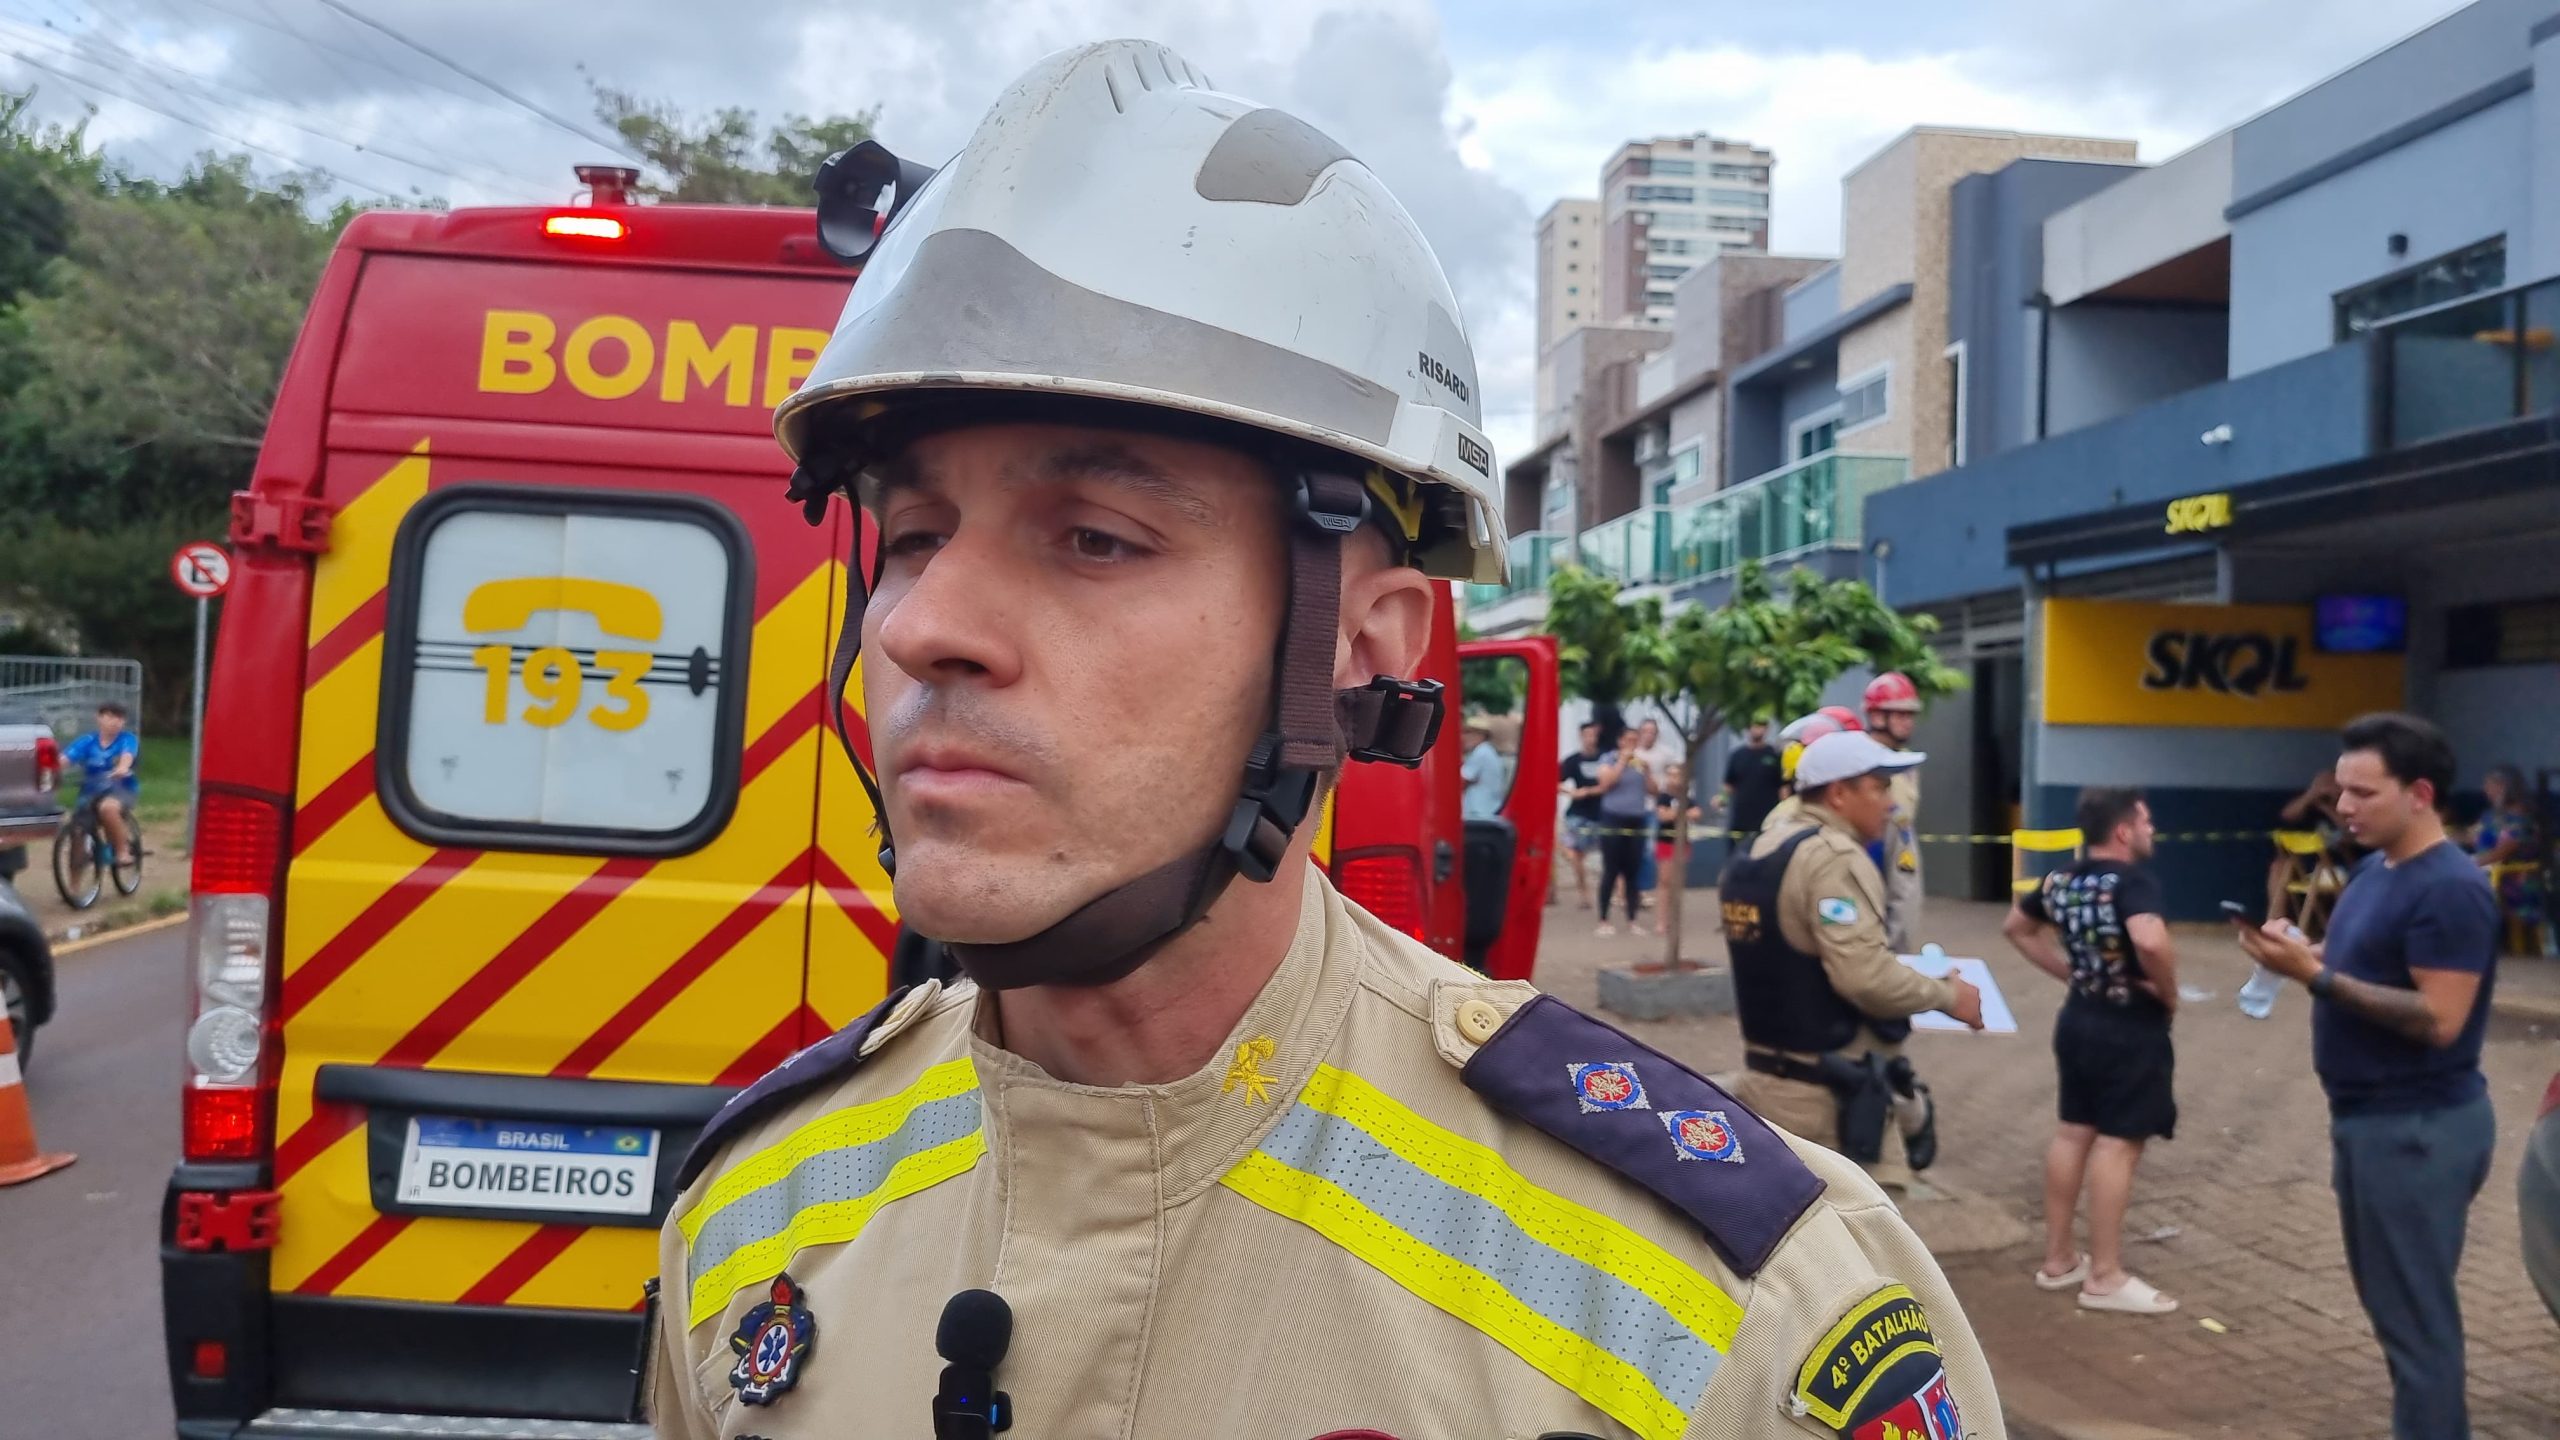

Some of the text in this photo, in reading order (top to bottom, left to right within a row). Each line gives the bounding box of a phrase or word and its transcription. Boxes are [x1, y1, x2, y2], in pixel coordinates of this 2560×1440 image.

[1418, 351, 1470, 406] RISARDI
[1459, 436, 1488, 473] MSA
[2164, 493, 2231, 535] SKOL
[2143, 629, 2309, 697] SKOL
[471, 645, 655, 733] 193
[496, 1130, 571, 1151] BRASIL
[428, 1160, 635, 1198] BOMBEIROS
[1850, 1304, 1929, 1366] BATALHÃO
